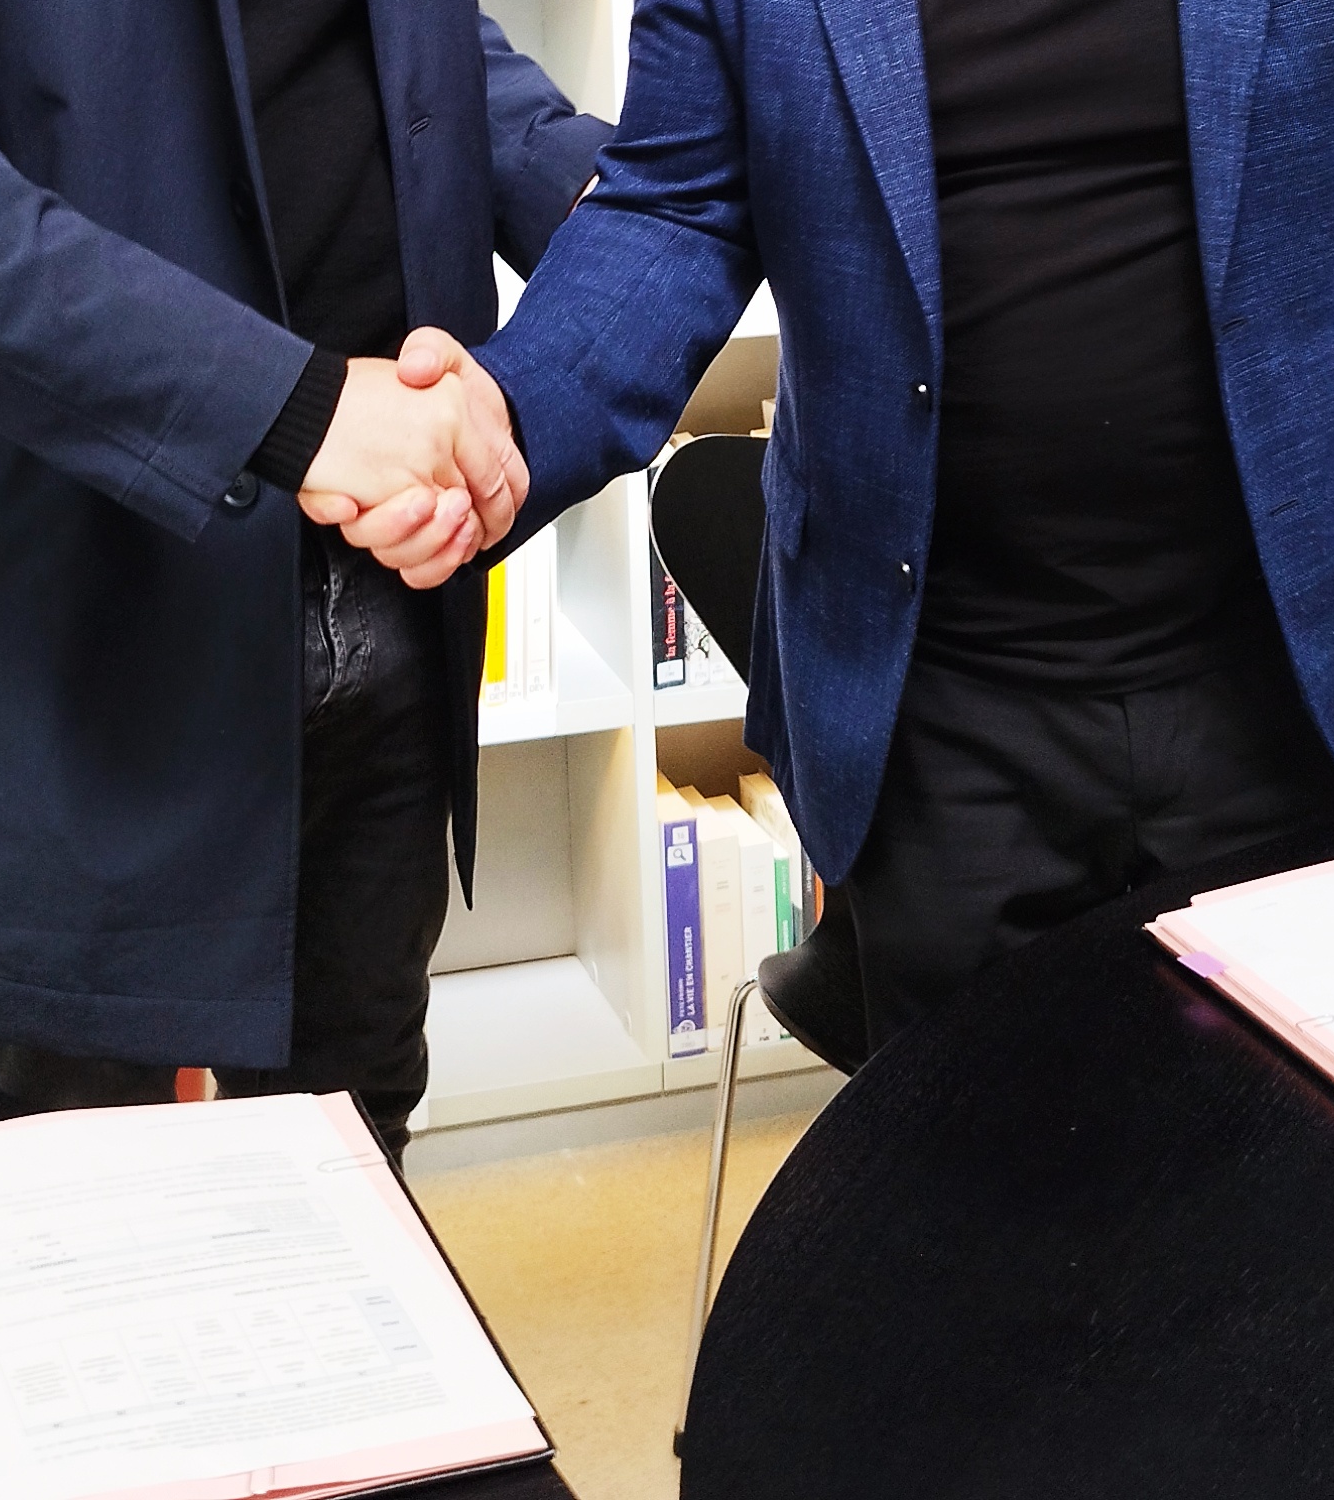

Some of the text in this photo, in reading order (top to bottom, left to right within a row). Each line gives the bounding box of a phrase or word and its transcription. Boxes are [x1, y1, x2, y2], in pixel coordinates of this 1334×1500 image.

[665, 606, 677, 642] femme
[683, 926, 696, 1014] LA VIE EN CHANTIER
